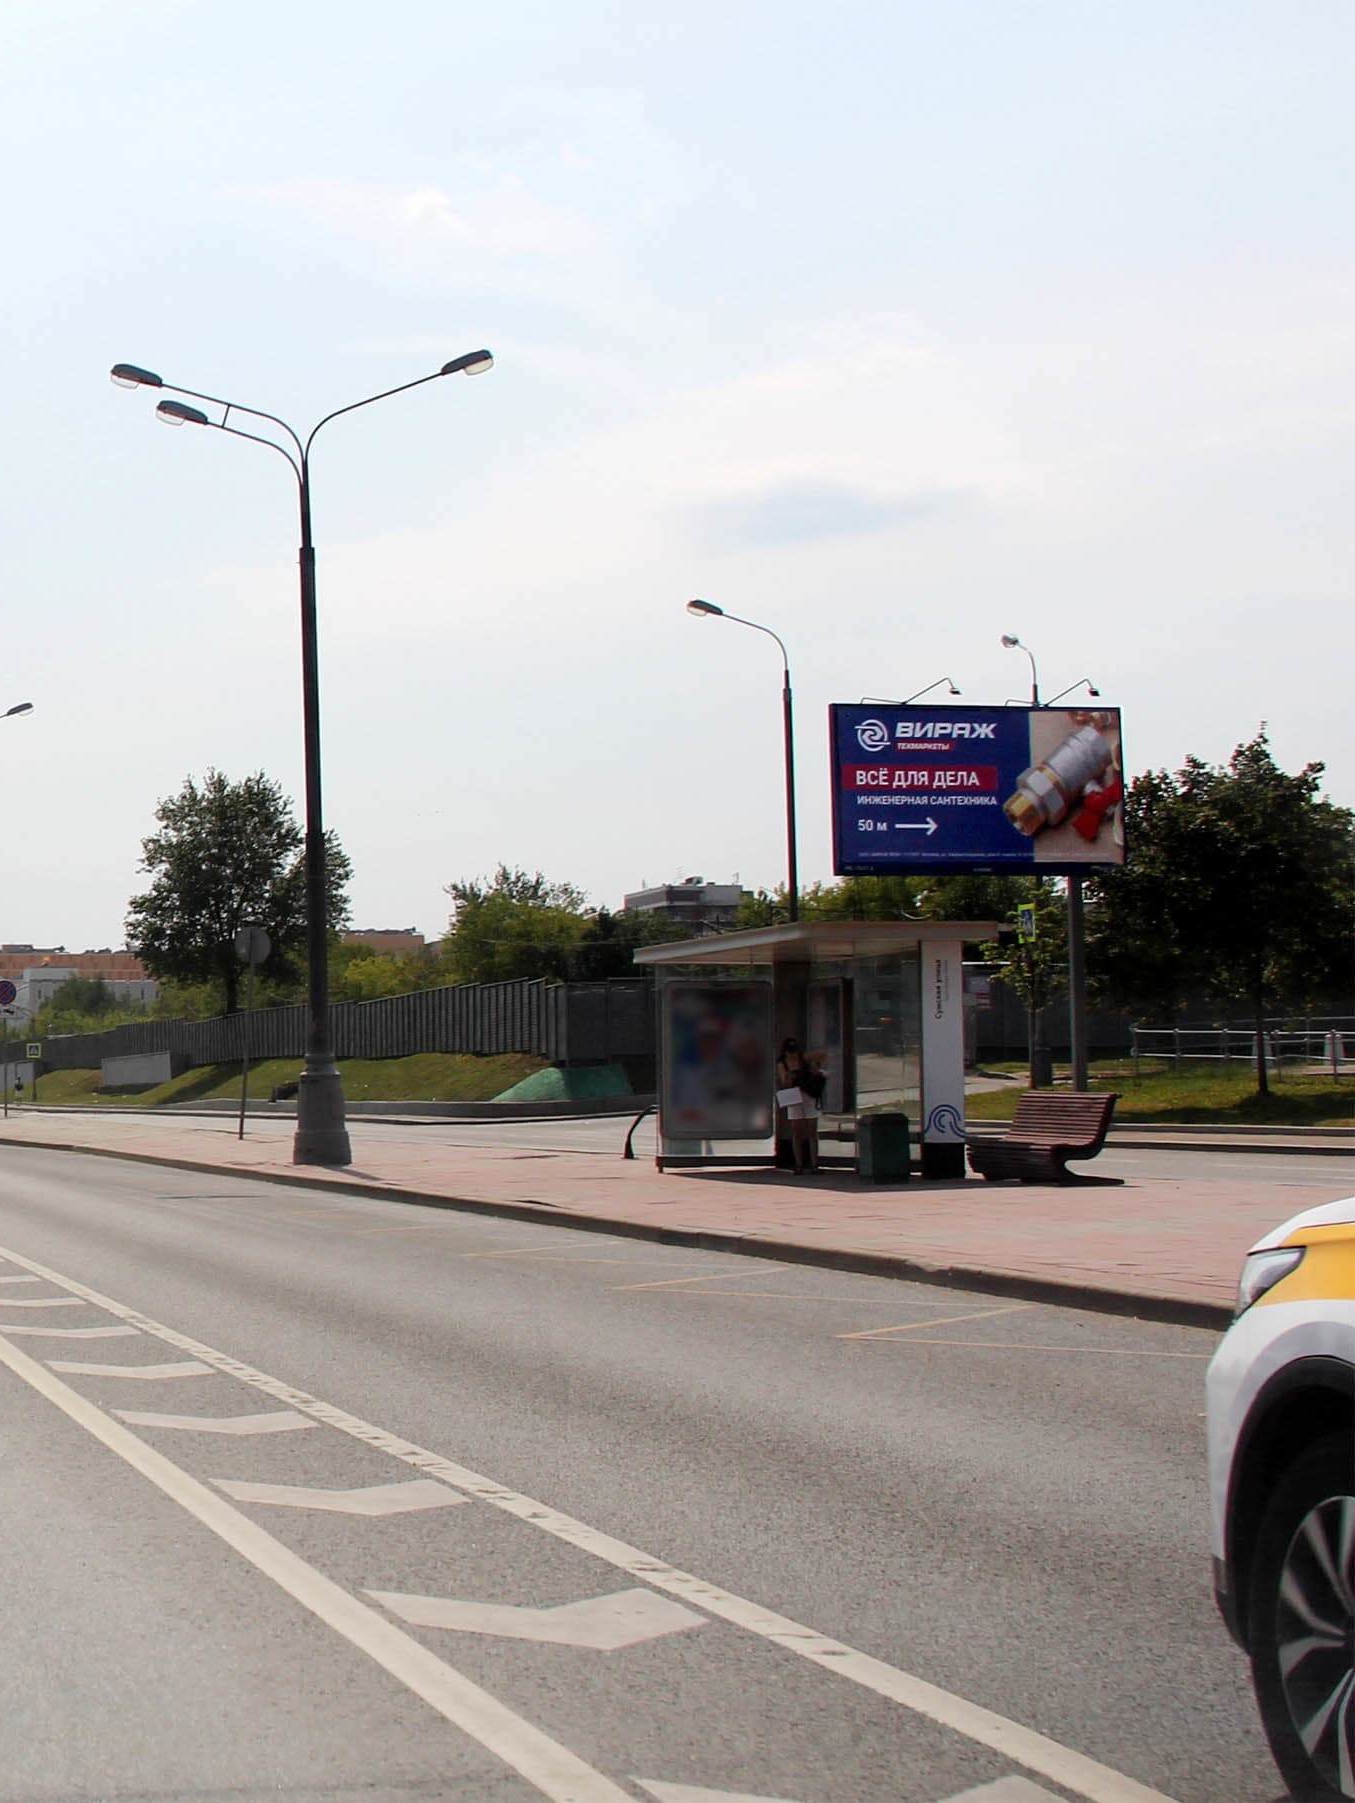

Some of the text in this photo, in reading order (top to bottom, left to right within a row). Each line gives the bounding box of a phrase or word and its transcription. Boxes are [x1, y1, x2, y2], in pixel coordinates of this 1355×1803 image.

[895, 722, 997, 739] ВИРАЖ
[897, 742, 950, 751] ТЕХМАРКЕТЫ
[855, 767, 980, 789] ВСЁ ДЛЯ ДЕЛА
[857, 795, 997, 806] ИНЖЕНЕРНАЯ САНТЕХНИКА
[857, 819, 887, 831] 50 м
